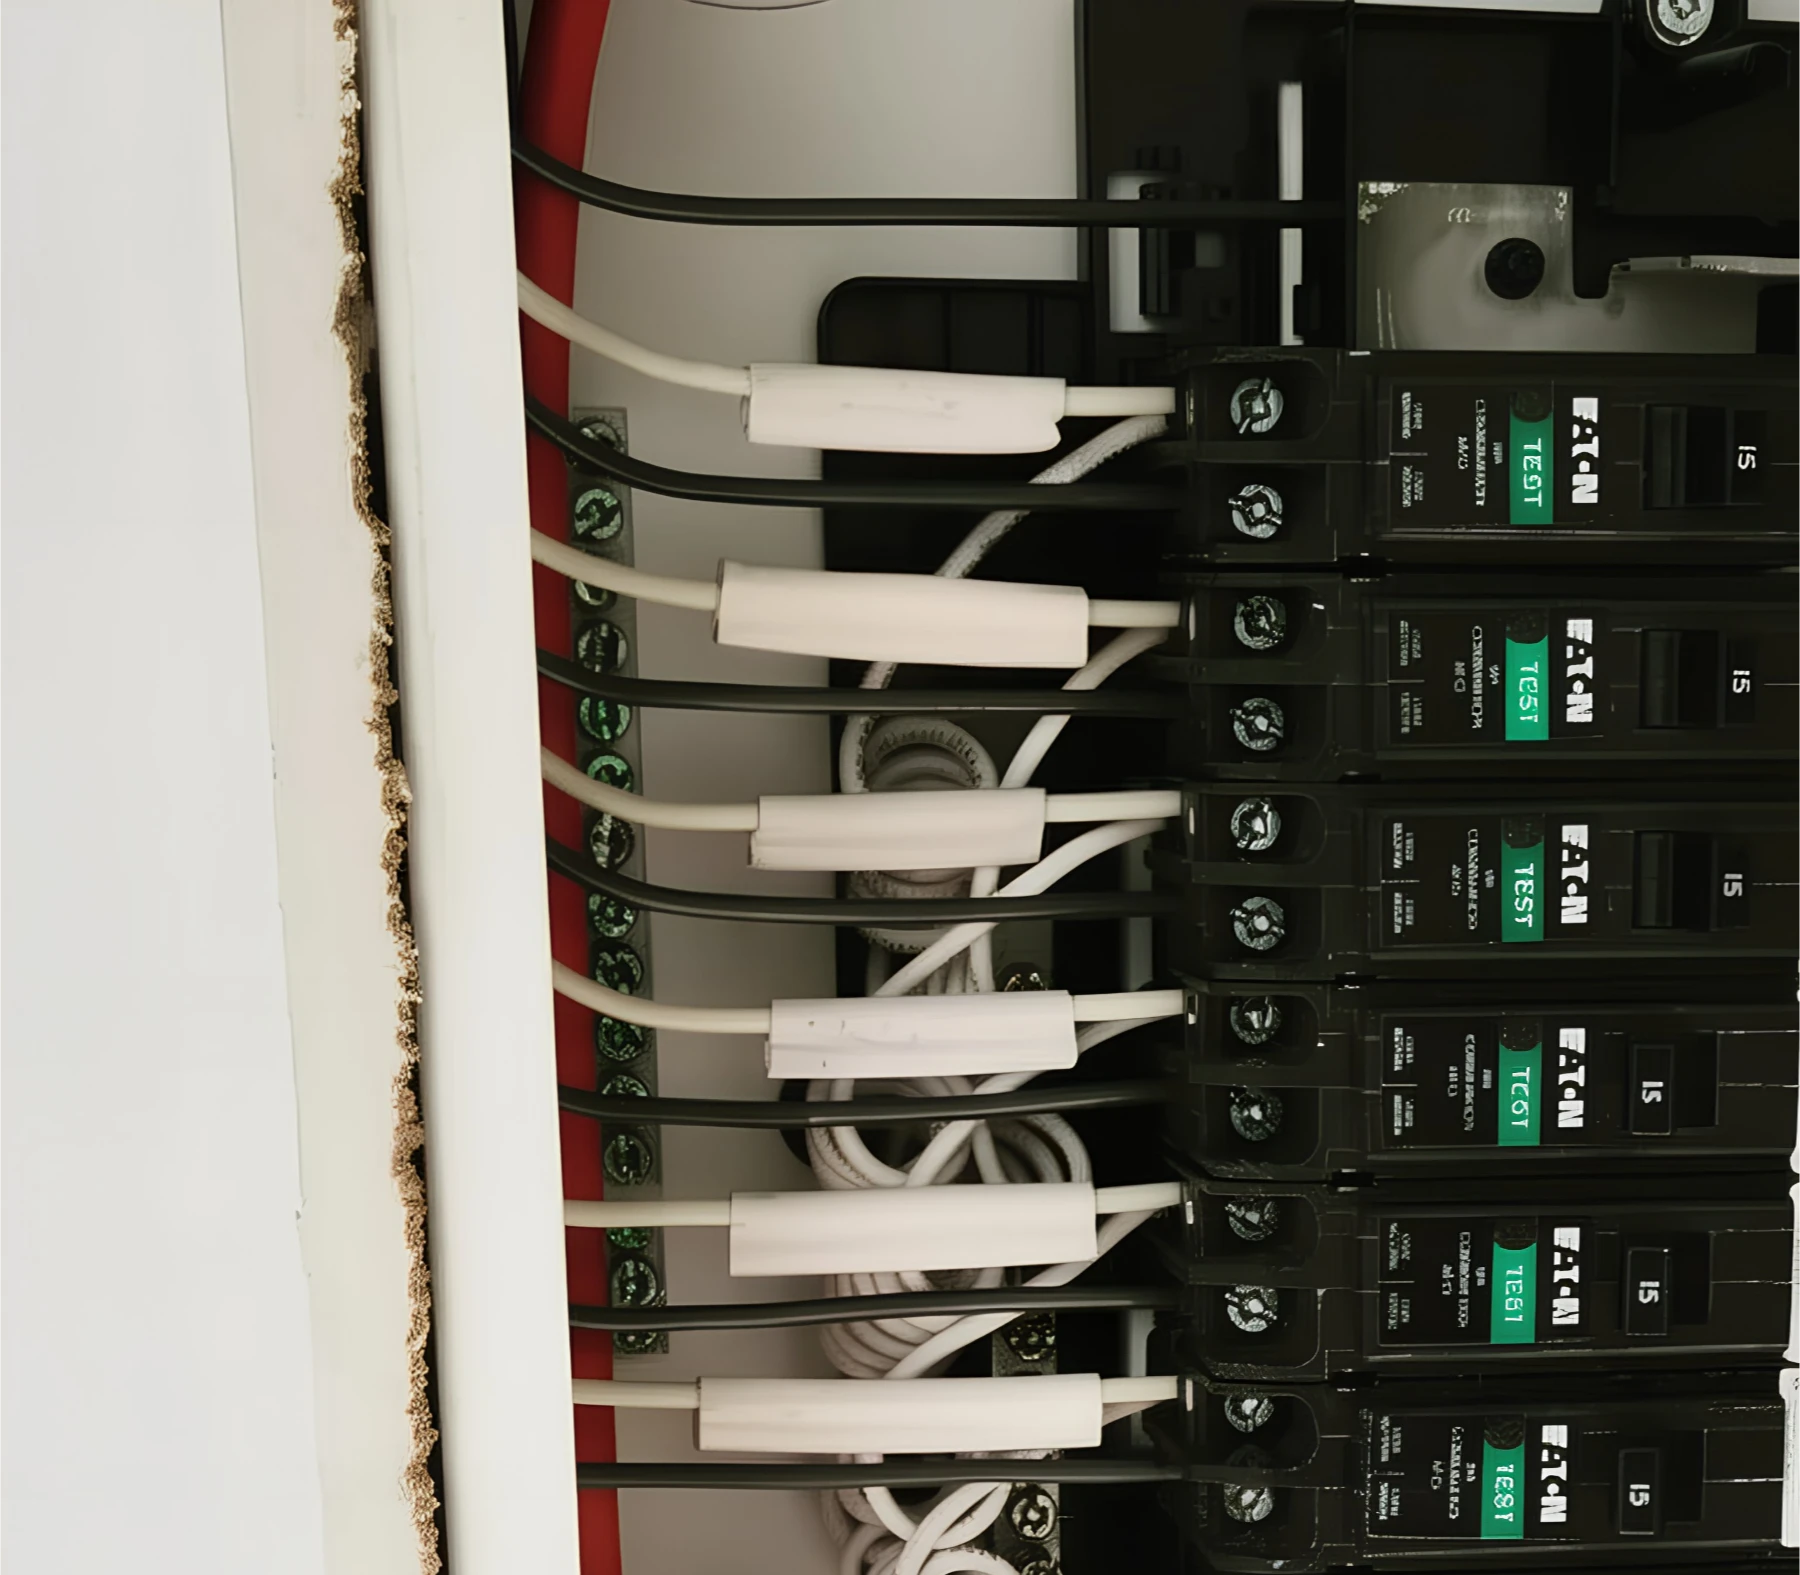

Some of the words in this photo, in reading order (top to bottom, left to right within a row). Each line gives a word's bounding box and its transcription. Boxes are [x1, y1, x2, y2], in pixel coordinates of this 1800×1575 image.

[1571, 397, 1599, 504] EATON
[1738, 445, 1757, 470] 15
[1566, 619, 1593, 723] EATON
[1732, 670, 1750, 693] 15
[1514, 862, 1535, 928] TEST
[1560, 824, 1589, 924] EATON
[1724, 873, 1742, 897] 15
[1557, 1027, 1586, 1128] EATON
[1642, 1081, 1664, 1104] 15
[1552, 1227, 1580, 1325] EATON
[1638, 1281, 1660, 1304] 15
[1540, 1424, 1568, 1523] EATON
[1629, 1484, 1650, 1507] 15
